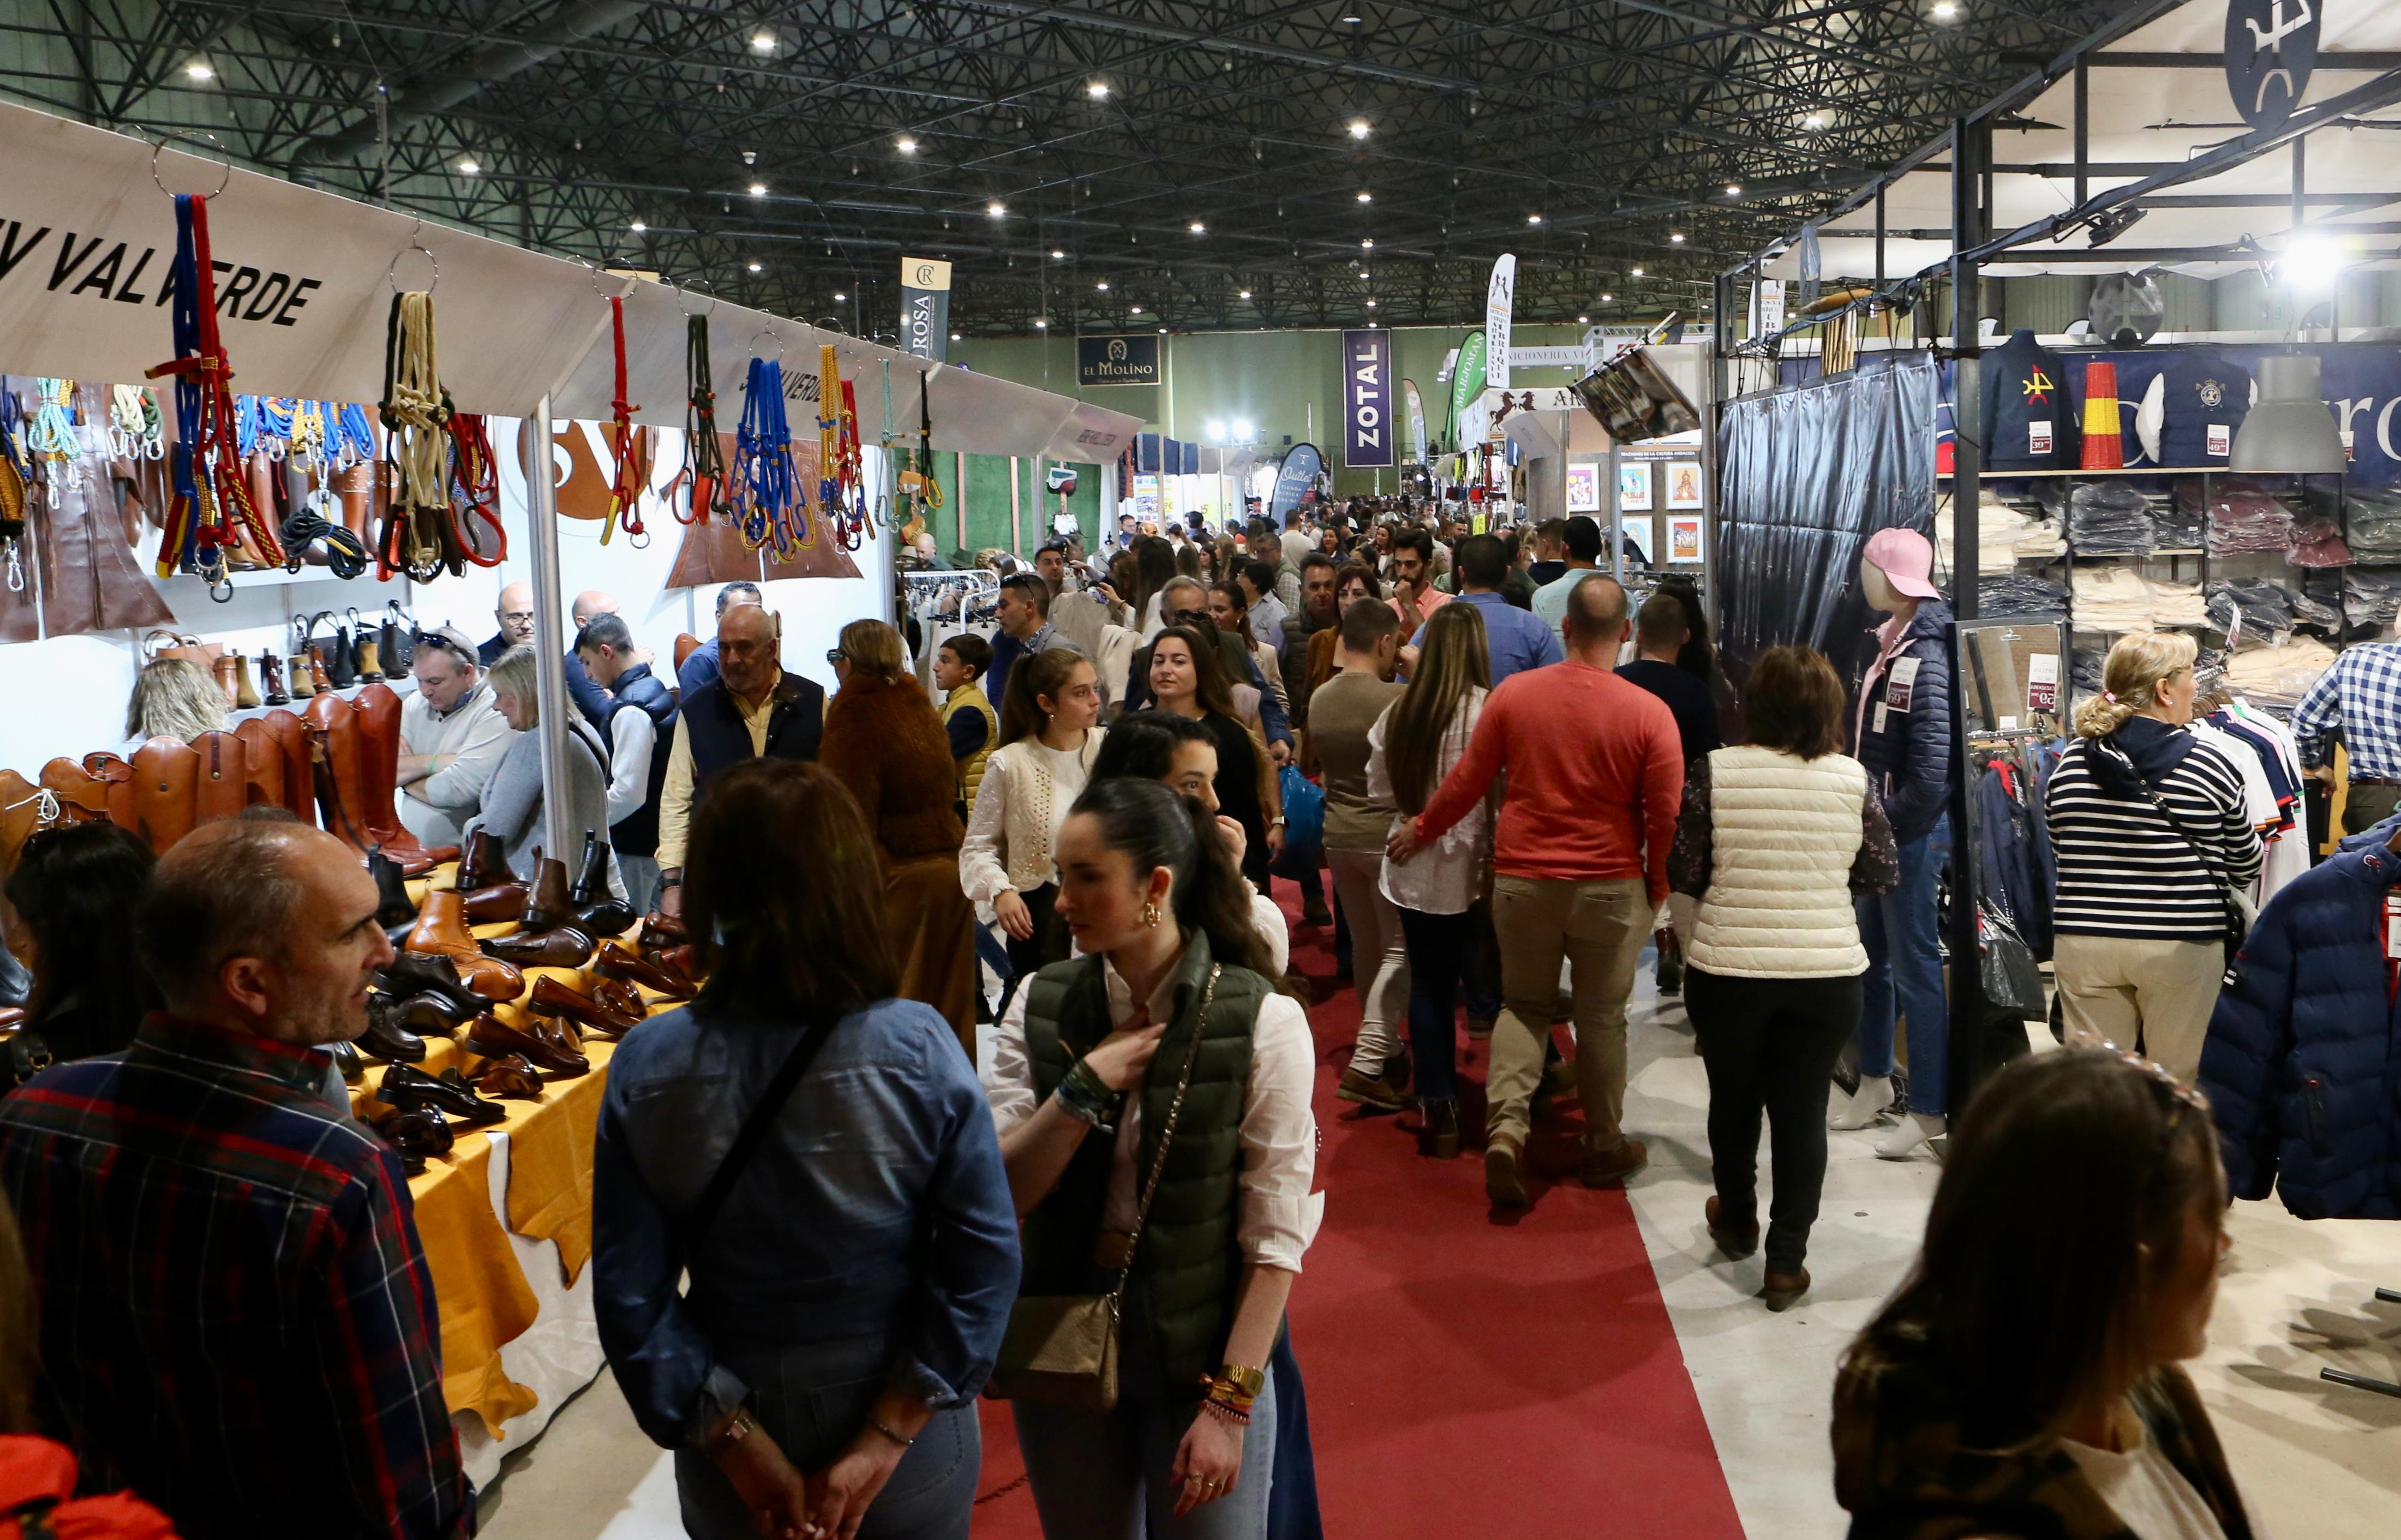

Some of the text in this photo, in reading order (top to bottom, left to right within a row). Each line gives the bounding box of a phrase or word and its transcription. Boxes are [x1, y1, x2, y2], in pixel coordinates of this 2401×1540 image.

[913, 295, 929, 349] ROSA
[1085, 367, 1095, 376] EL
[1456, 334, 1484, 407] MARJOMAN
[1356, 344, 1380, 448] ZOTAL
[1280, 466, 1313, 483] Outlet
[1888, 693, 1901, 704] 69
